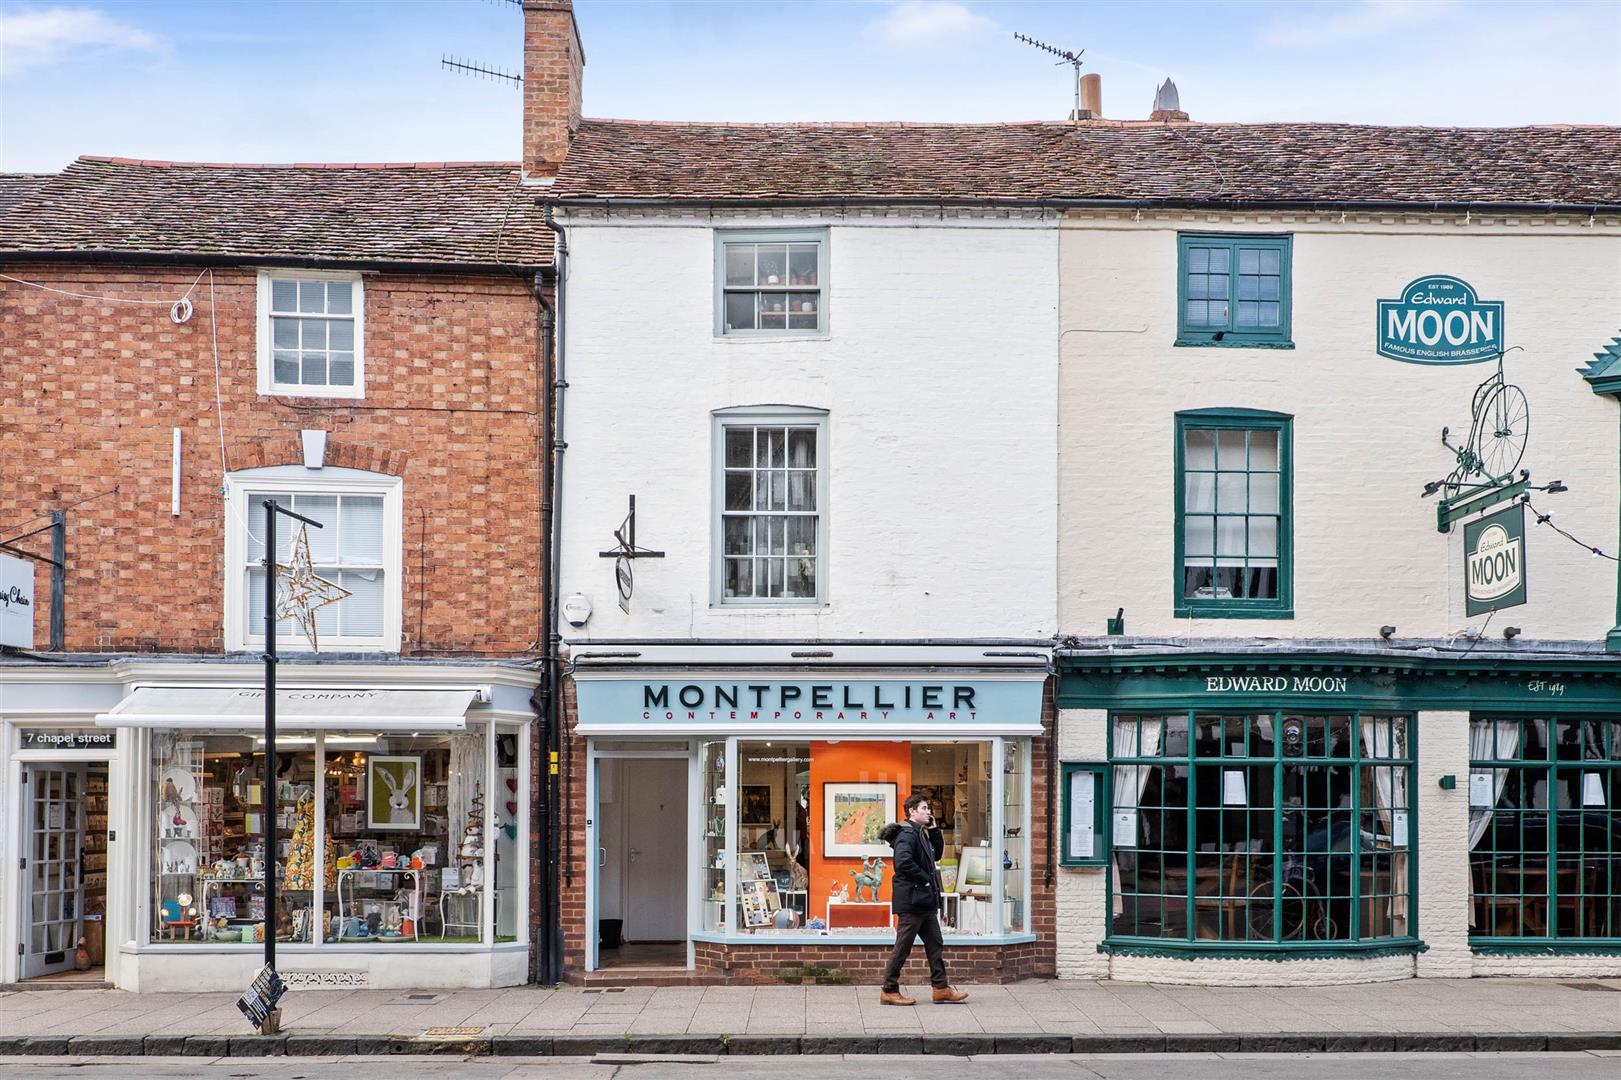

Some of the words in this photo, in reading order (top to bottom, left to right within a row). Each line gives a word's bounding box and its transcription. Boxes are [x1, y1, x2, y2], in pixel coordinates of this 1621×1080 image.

[1411, 292, 1467, 305] Edward
[1387, 309, 1494, 346] MOON
[1384, 342, 1416, 355] FAMOUS
[1416, 349, 1450, 357] ENGLISH
[1480, 536, 1504, 553] Edward
[1472, 547, 1516, 586] MOON
[1206, 676, 1288, 692] EDWARD
[1292, 676, 1348, 692] MOON
[288, 692, 378, 700] COMPANY
[643, 684, 976, 709] MONTPELLIER
[643, 711, 890, 720] CONTEMPORARY
[927, 711, 977, 720] ART
[27, 733, 34, 743] 7
[37, 733, 74, 745] chapel
[78, 733, 112, 743] street
